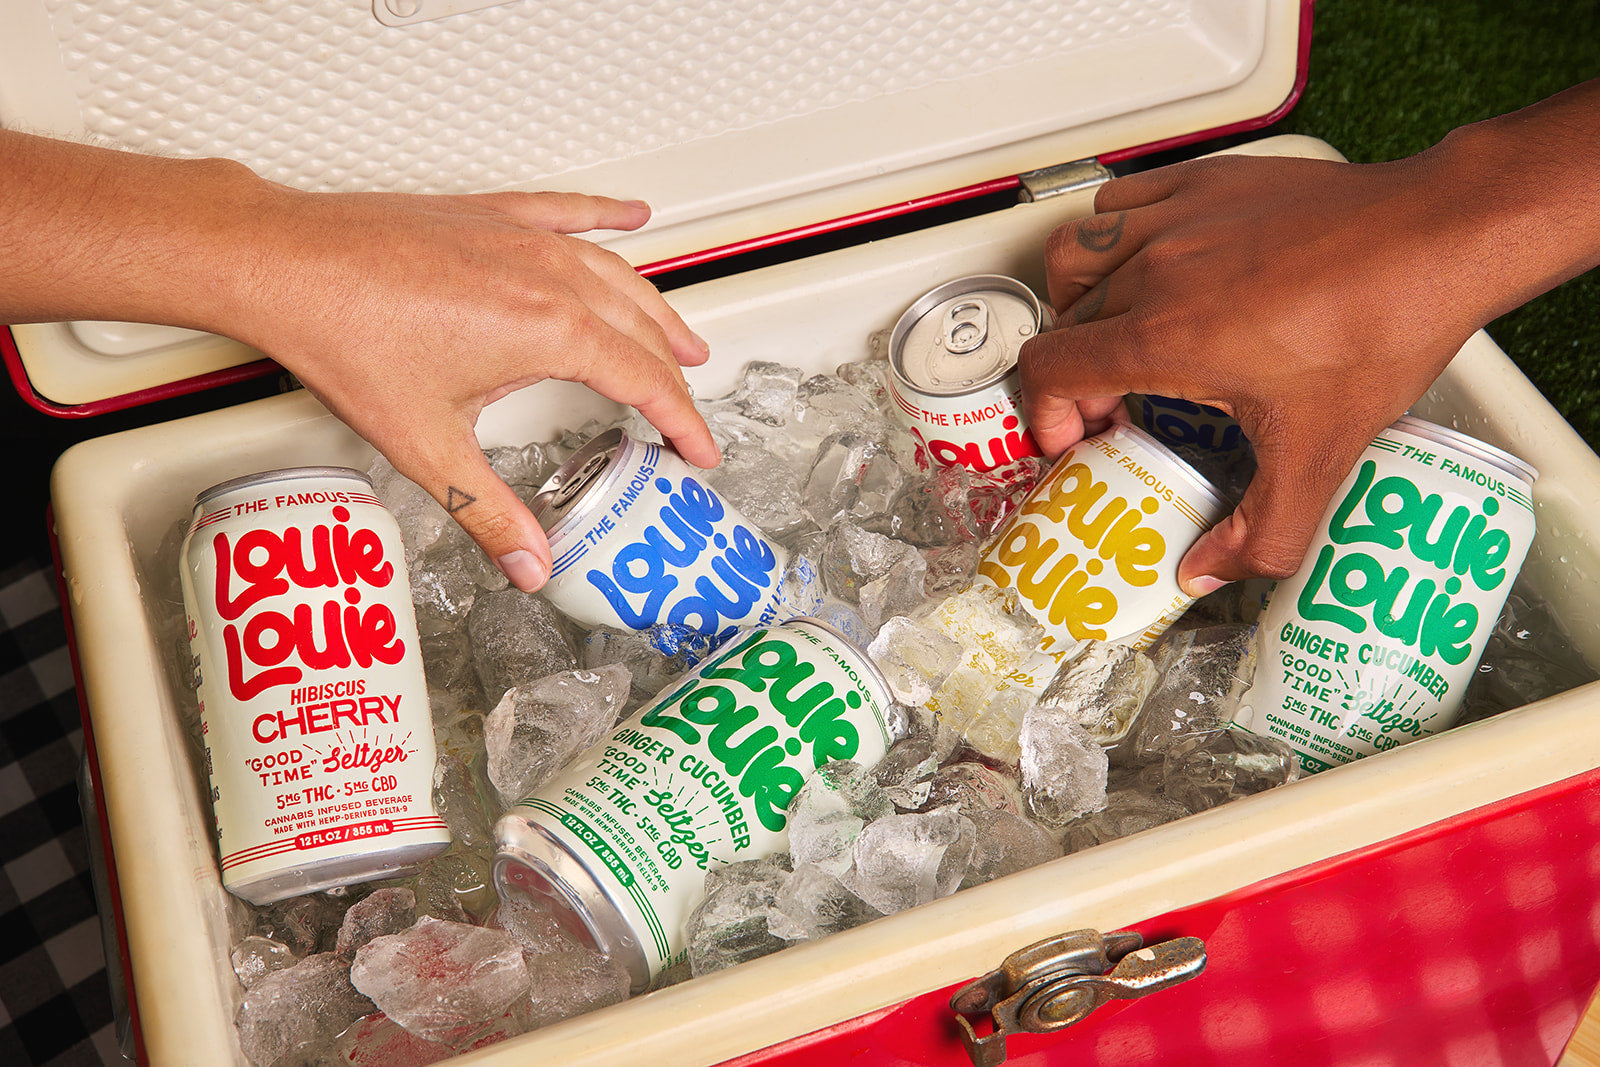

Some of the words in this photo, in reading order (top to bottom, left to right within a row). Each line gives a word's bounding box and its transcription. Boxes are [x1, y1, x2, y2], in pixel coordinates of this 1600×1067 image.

[921, 410, 949, 426] THE
[953, 396, 1017, 427] FAMOUS
[1143, 400, 1241, 452] Lou
[233, 498, 269, 517] THE
[275, 491, 350, 508] FAMOUS
[1096, 440, 1120, 460] THE
[1117, 456, 1175, 502] FAMOUS
[1402, 445, 1436, 466] THE
[1440, 458, 1506, 497] FAMOUS
[585, 516, 616, 546] THE
[611, 465, 655, 518] FAMOUS
[1020, 450, 1166, 587] Louie
[1328, 459, 1511, 592] Louie
[213, 505, 395, 621] Louie
[586, 477, 724, 630] Louie
[667, 525, 776, 640] ouie
[1297, 544, 1479, 666] Louie
[223, 587, 406, 701] Louie
[794, 629, 822, 646] THE
[822, 646, 872, 703] FAMOUS
[1280, 622, 1350, 664] GINGER
[1358, 643, 1450, 702] CUCUMBER
[252, 694, 403, 744] CHERRY
[290, 679, 366, 706] HIBISCUS
[700, 629, 859, 769] Louie
[1310, 705, 1341, 731] THC
[1341, 691, 1422, 737] Seltzer
[322, 742, 408, 774] Seltzer
[641, 679, 804, 833] Louie
[1265, 713, 1311, 738] CANNABIS
[1313, 734, 1353, 756] INFUSED
[1269, 725, 1288, 738] MADE
[1289, 733, 1307, 746] WITH
[264, 810, 314, 827] CANNABIS
[317, 801, 362, 816] INFUSED
[365, 795, 413, 808] BEVERAGE
[274, 825, 294, 835] MADE
[296, 820, 316, 831] WITH
[319, 808, 378, 825] HEMP-DERIVED
[380, 805, 408, 815] DELTA-9
[302, 785, 335, 804] THC
[371, 775, 398, 792] CBD
[612, 728, 675, 765] GINGER
[679, 754, 751, 853] CUCUMBER
[374, 822, 390, 833] mL
[563, 796, 580, 808] MADE
[580, 805, 596, 819] WITH
[594, 817, 638, 862] HEMP-DERIVED
[636, 862, 659, 892] DELTA-9
[564, 787, 602, 813] CANNABIS
[602, 811, 635, 845] INFUSED
[634, 845, 670, 894] BEVERAGE
[607, 788, 637, 815] THC
[656, 840, 683, 870] CBD
[643, 788, 710, 871] Seltzer
[616, 867, 631, 883] mL
